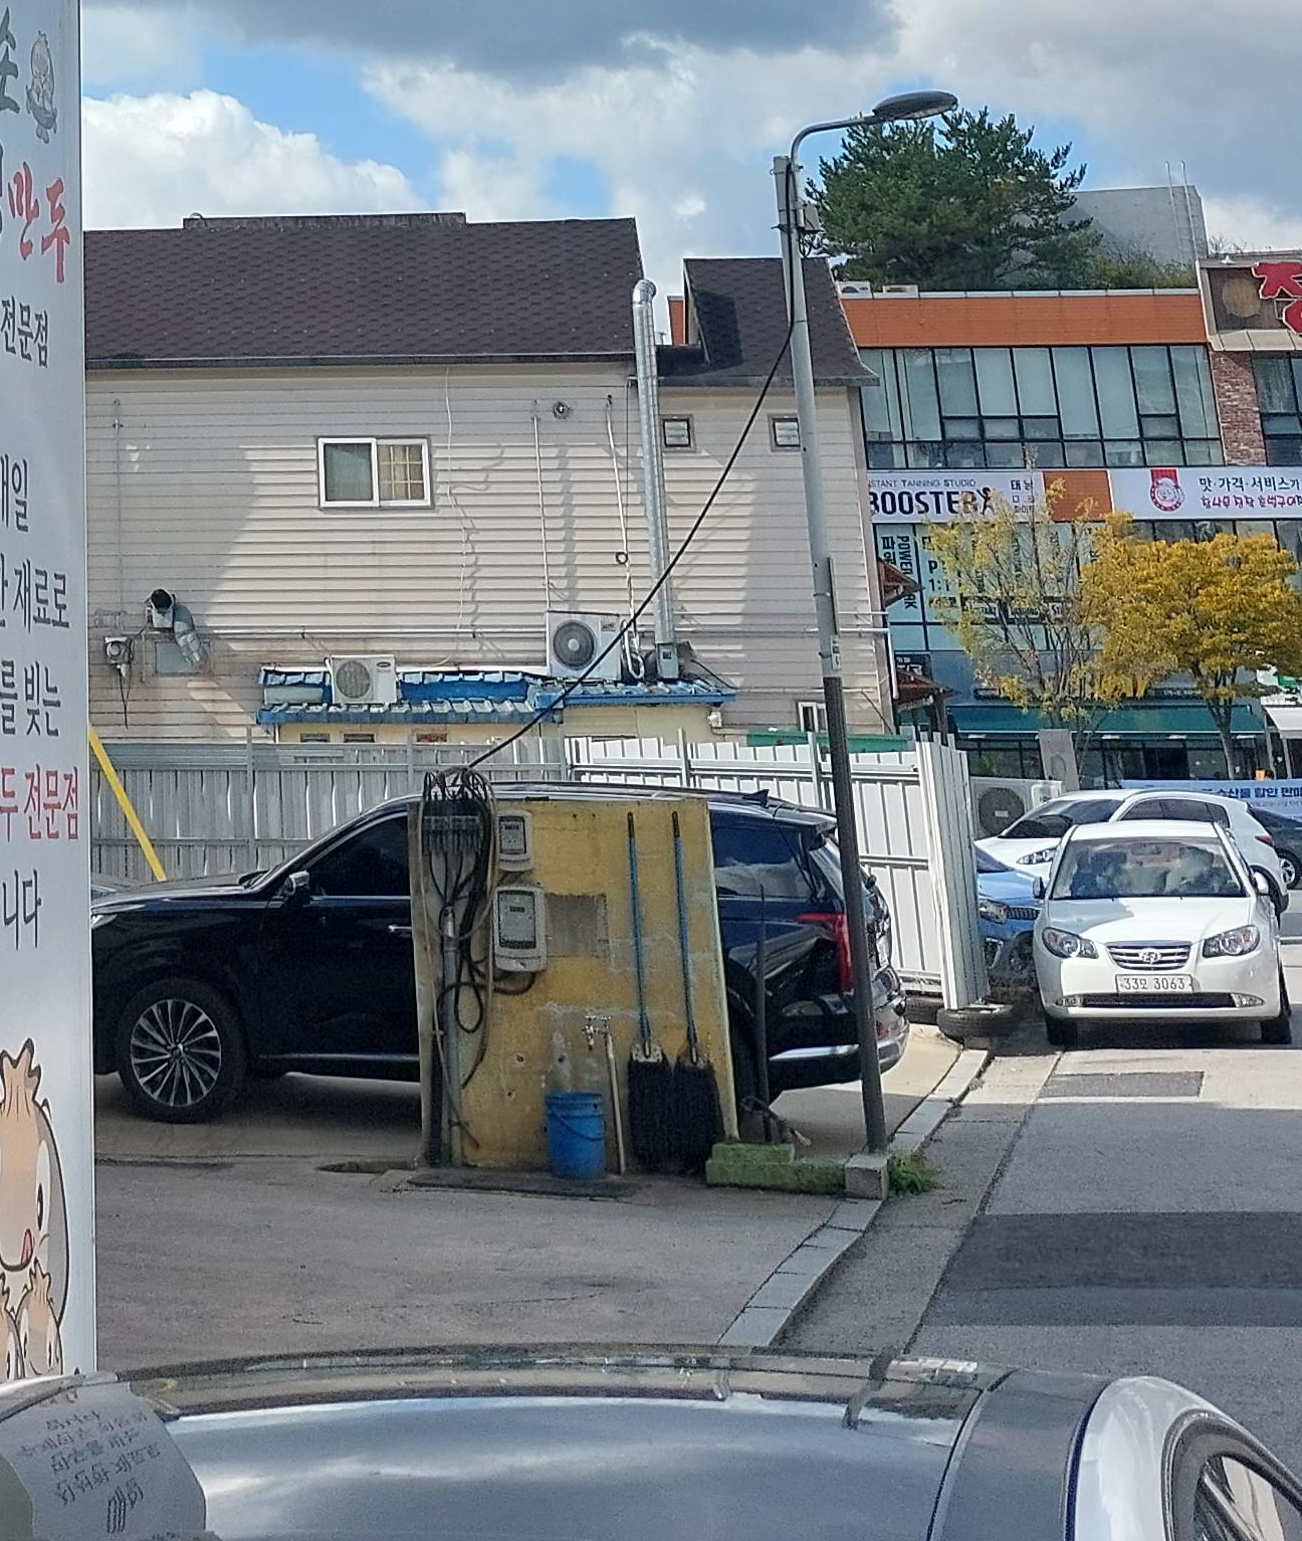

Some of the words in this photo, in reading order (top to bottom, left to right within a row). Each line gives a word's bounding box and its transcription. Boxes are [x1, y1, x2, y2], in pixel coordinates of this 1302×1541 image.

[13, 558, 69, 631] 재료로
[24, 661, 62, 736] 빚는
[23, 764, 79, 839] 전문점
[1153, 977, 1185, 990] 3063
